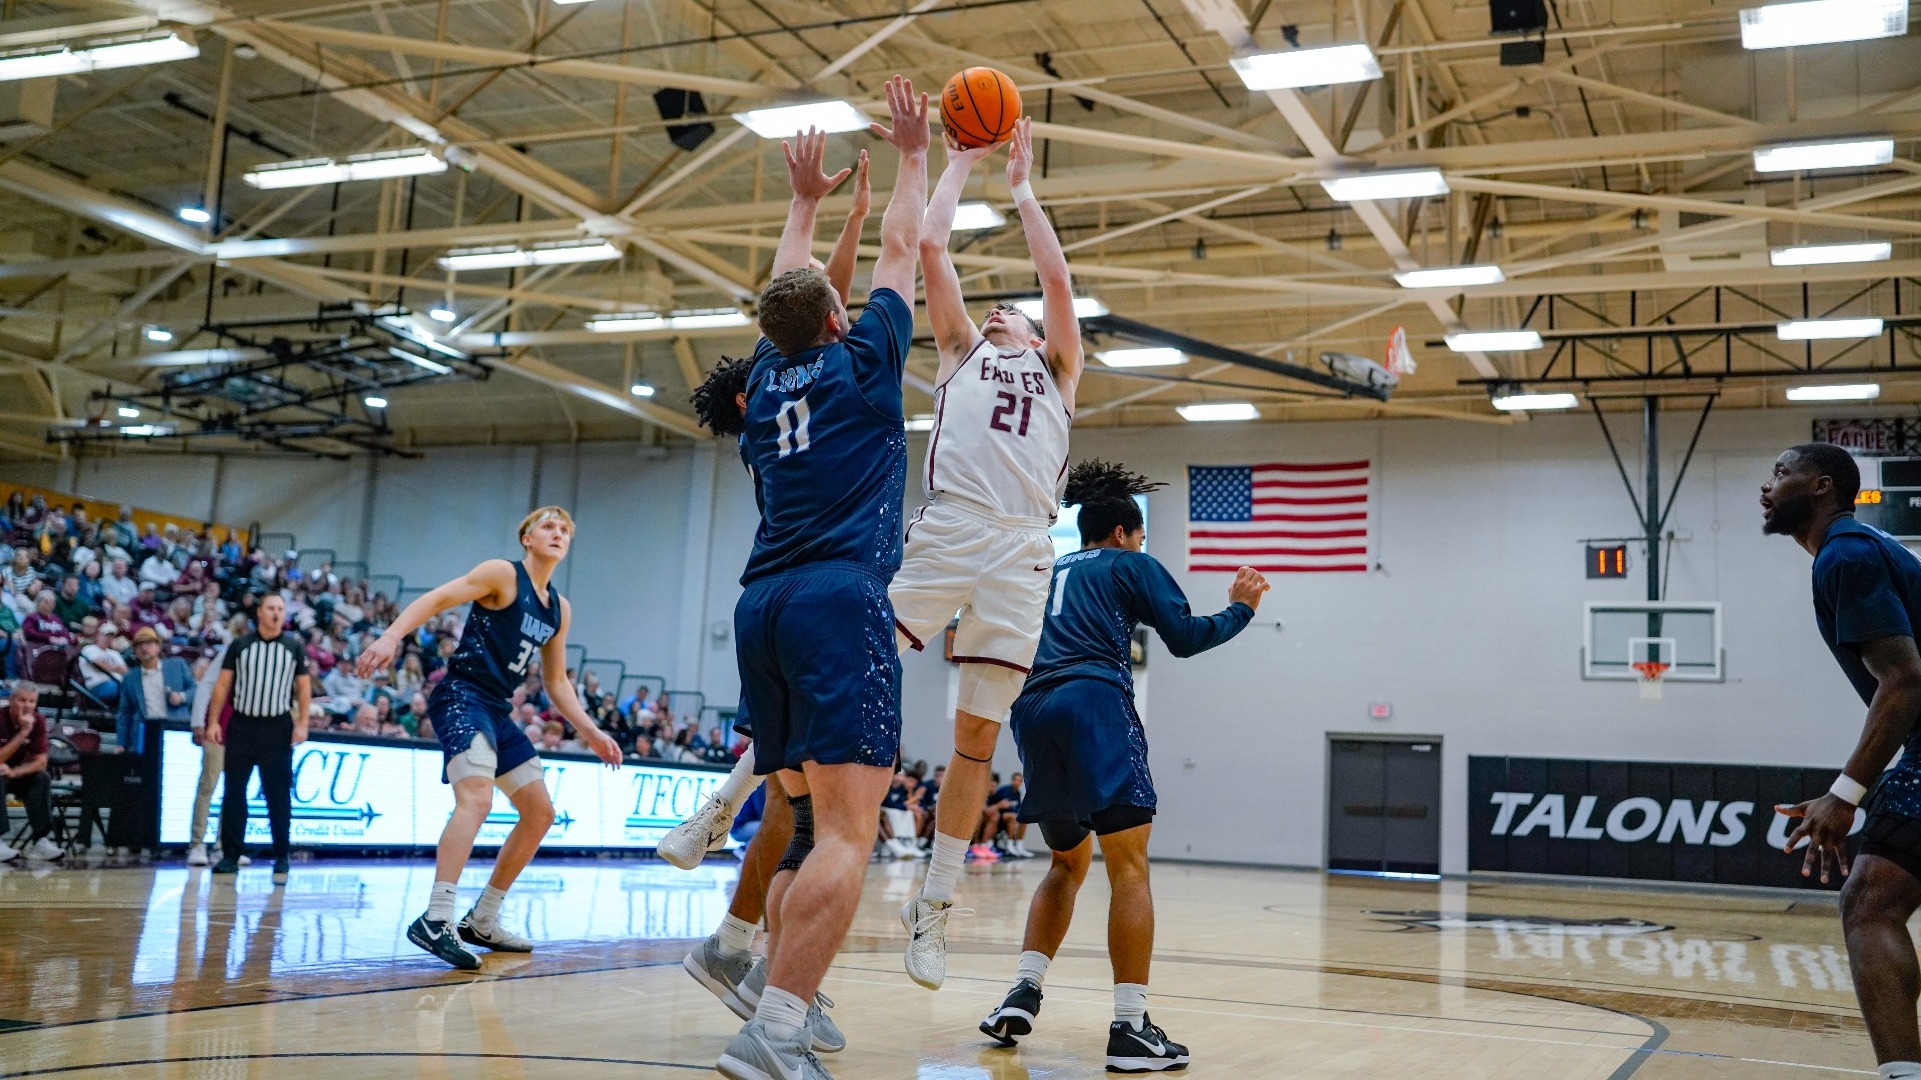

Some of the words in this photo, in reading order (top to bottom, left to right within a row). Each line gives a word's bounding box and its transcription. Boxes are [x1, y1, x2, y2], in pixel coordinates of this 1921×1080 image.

[990, 390, 1032, 437] 21
[1599, 549, 1623, 574] 11
[1051, 567, 1071, 616] 1
[507, 639, 539, 676] 3
[1490, 791, 1755, 847] TALONS
[1767, 804, 1867, 850] U
